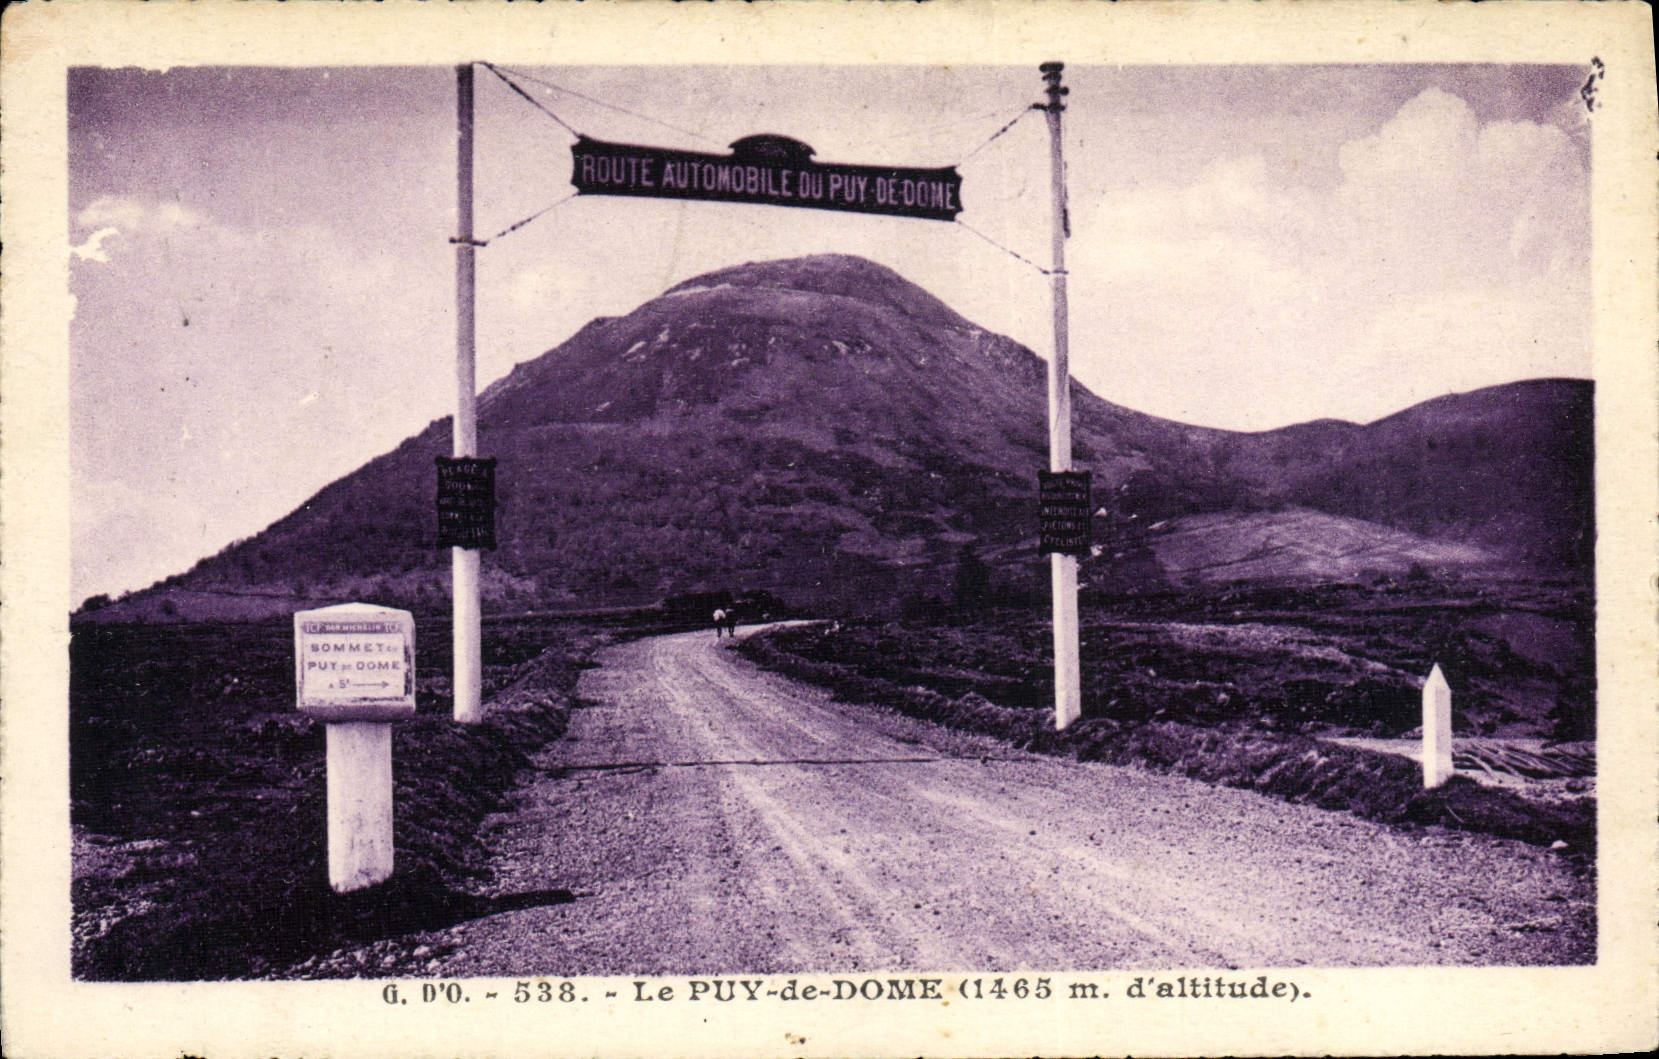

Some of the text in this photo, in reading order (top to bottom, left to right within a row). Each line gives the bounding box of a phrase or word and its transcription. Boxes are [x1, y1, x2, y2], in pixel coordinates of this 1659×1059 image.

[582, 153, 654, 187] ROUTE
[662, 160, 792, 198] AUTOMOBILE
[799, 172, 823, 200] DU
[311, 643, 384, 652] SOMMET
[307, 660, 338, 671] PUY
